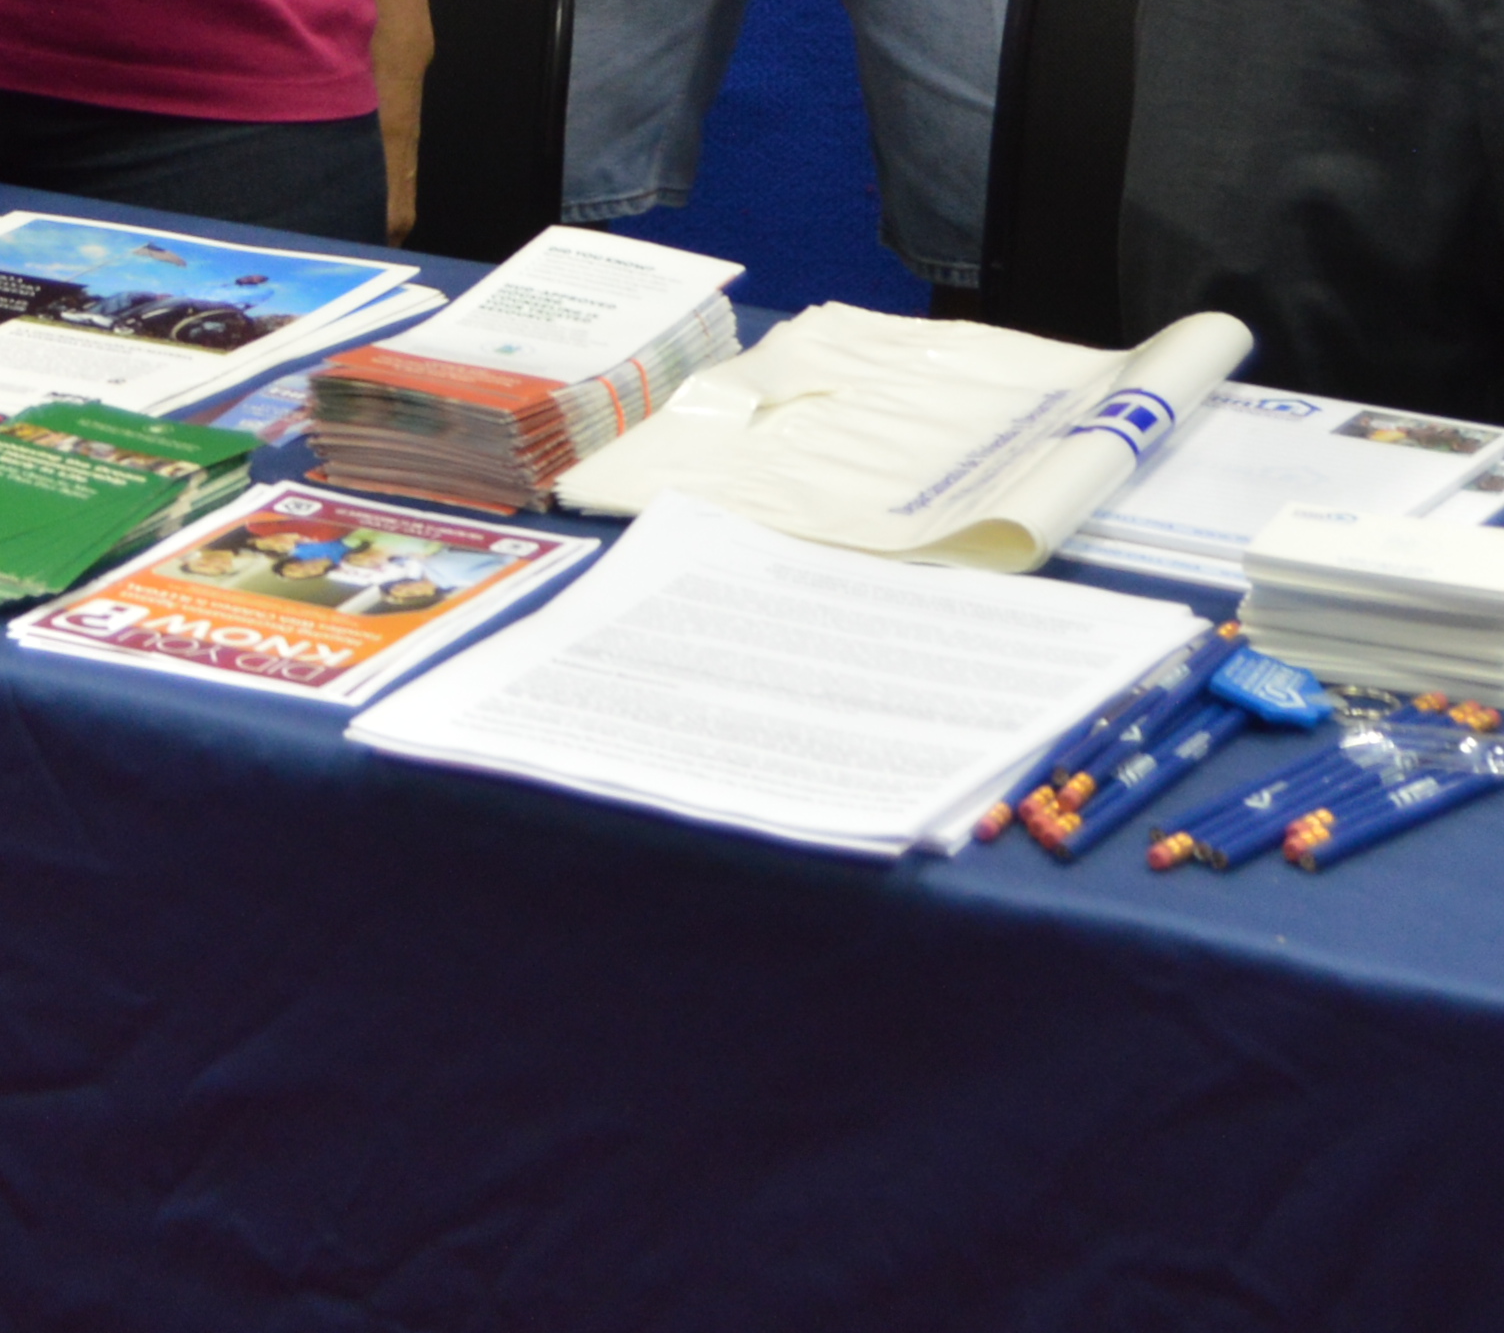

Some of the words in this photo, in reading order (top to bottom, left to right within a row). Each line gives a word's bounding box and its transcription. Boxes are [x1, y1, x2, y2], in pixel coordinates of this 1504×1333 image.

[116, 626, 222, 664] YOU
[141, 613, 354, 667] KNOW
[235, 652, 326, 682] DID
